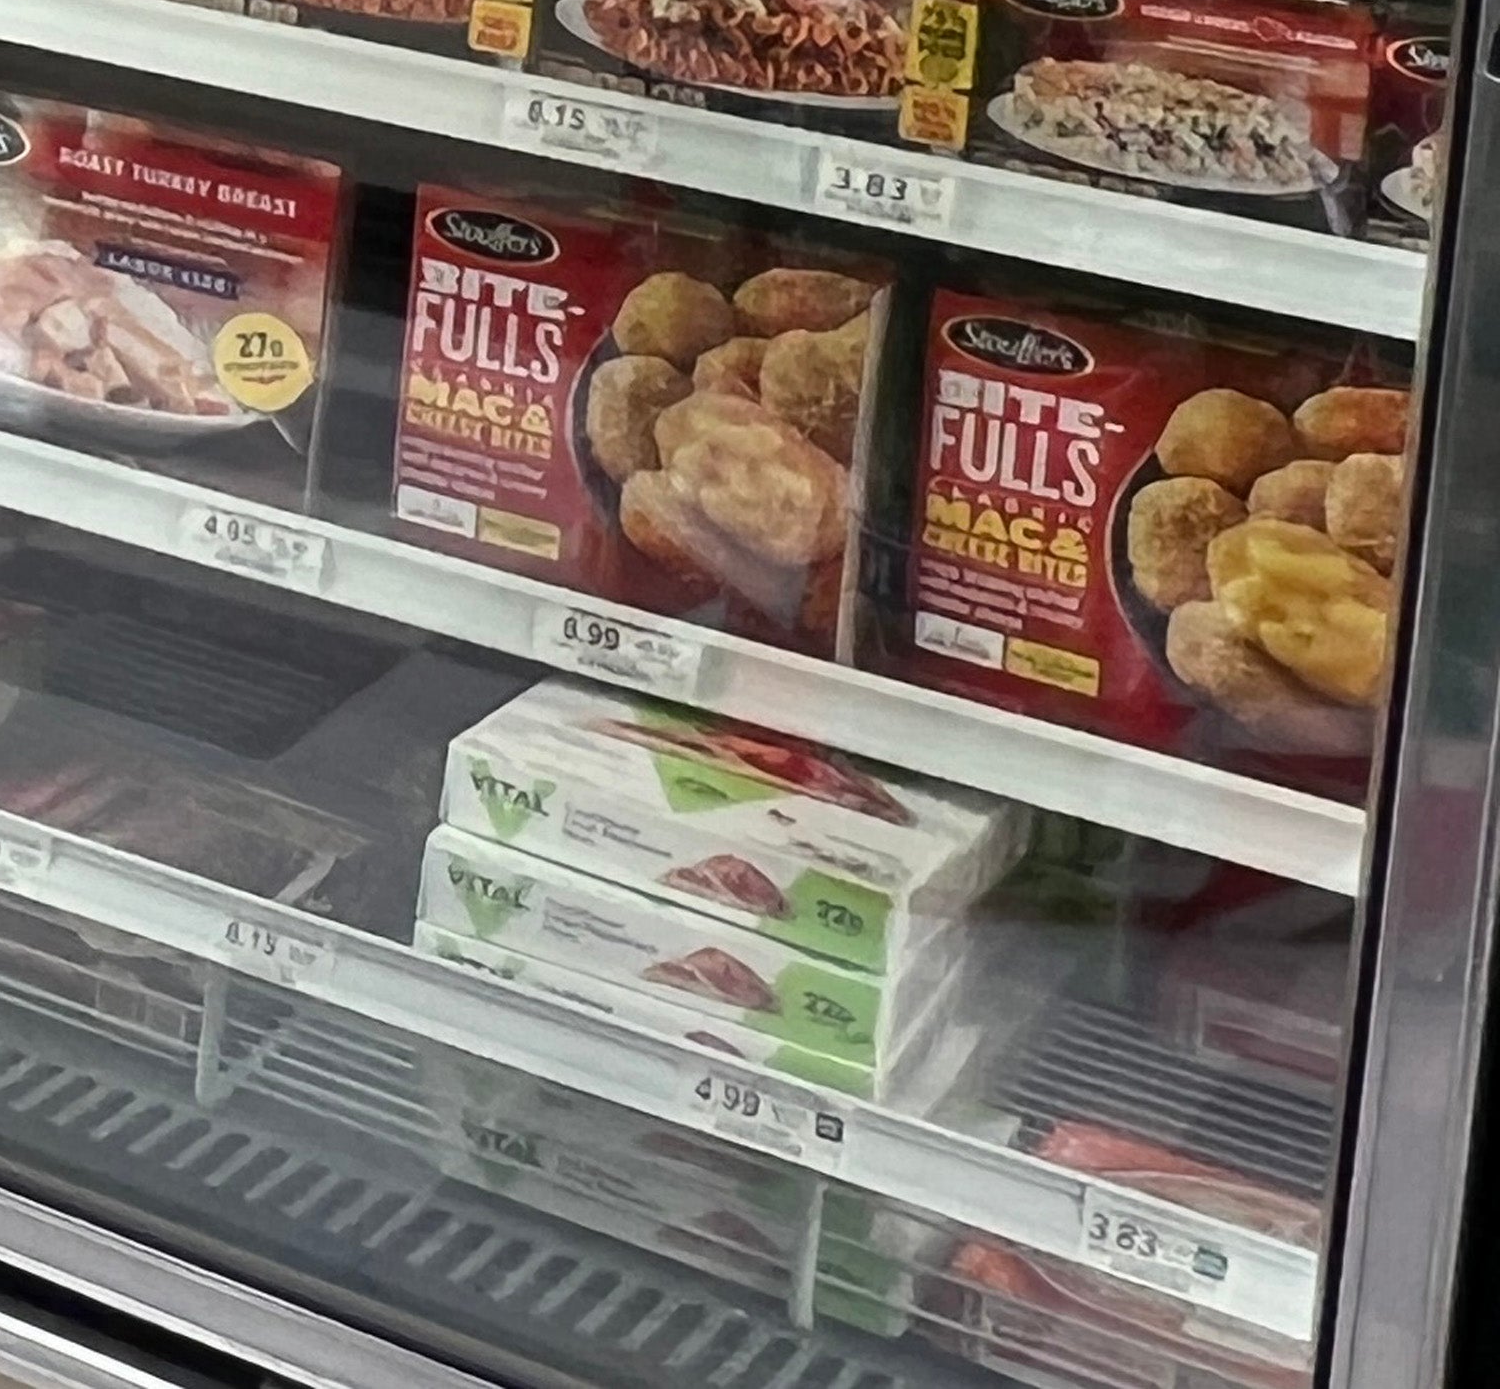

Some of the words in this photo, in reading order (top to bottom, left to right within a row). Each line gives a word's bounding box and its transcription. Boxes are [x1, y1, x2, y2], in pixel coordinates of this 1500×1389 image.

[58, 147, 126, 179] ROAST
[131, 163, 210, 200] TURKEY
[833, 165, 909, 201] 3.83
[411, 290, 564, 385] FULLS
[930, 403, 1101, 509] FULLS
[924, 492, 1046, 552] MAC
[467, 767, 552, 819] VITAL
[446, 860, 531, 913] VITAL
